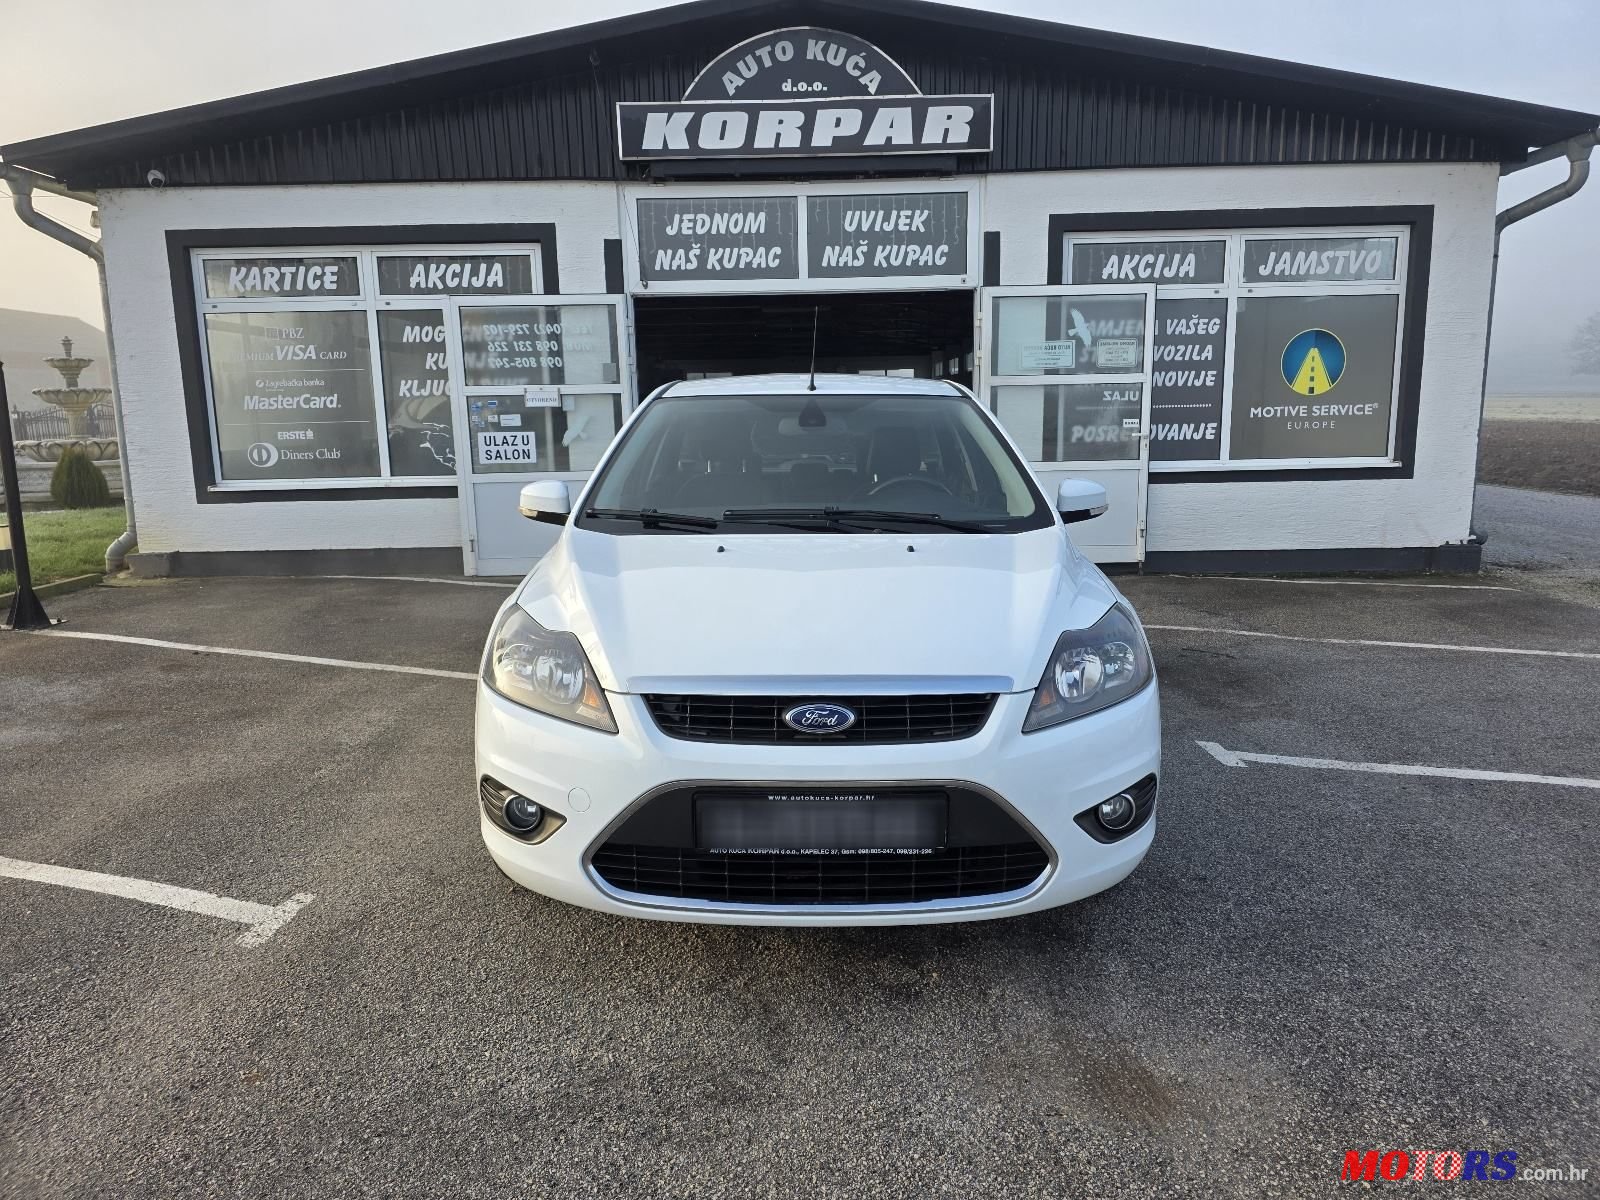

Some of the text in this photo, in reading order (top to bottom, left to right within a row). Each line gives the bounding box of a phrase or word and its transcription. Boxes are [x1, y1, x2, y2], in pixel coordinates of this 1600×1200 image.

[721, 38, 882, 96] AUTO KUĆA
[781, 79, 828, 93] d.o.o.
[642, 105, 974, 150] KORPAR
[665, 211, 766, 236] JEDNOM
[844, 209, 929, 233] UVIJEK
[654, 243, 782, 271] NAŠ KUPAC
[821, 240, 949, 268] NAŠ KUPAC
[1258, 250, 1382, 276] JAMSTVO
[1102, 252, 1197, 281] AKCIJA
[228, 265, 339, 293] KARTICE
[409, 262, 504, 290] AKCIJA
[282, 327, 305, 339] PBZ
[1166, 314, 1221, 336] VAŠEG
[275, 344, 317, 361] VISA
[319, 351, 347, 360] CARD
[1153, 344, 1213, 362] VOZILA
[303, 378, 325, 387] banka
[1153, 370, 1217, 388] NOVIJE
[1250, 406, 1307, 418] MOTIVE
[1287, 421, 1336, 429] EUROPE
[277, 431, 306, 440] ERSTE
[483, 434, 531, 447] ULAZ U
[280, 448, 341, 460] Diners Club
[484, 448, 532, 461] SALON
[802, 711, 837, 726] Ford
